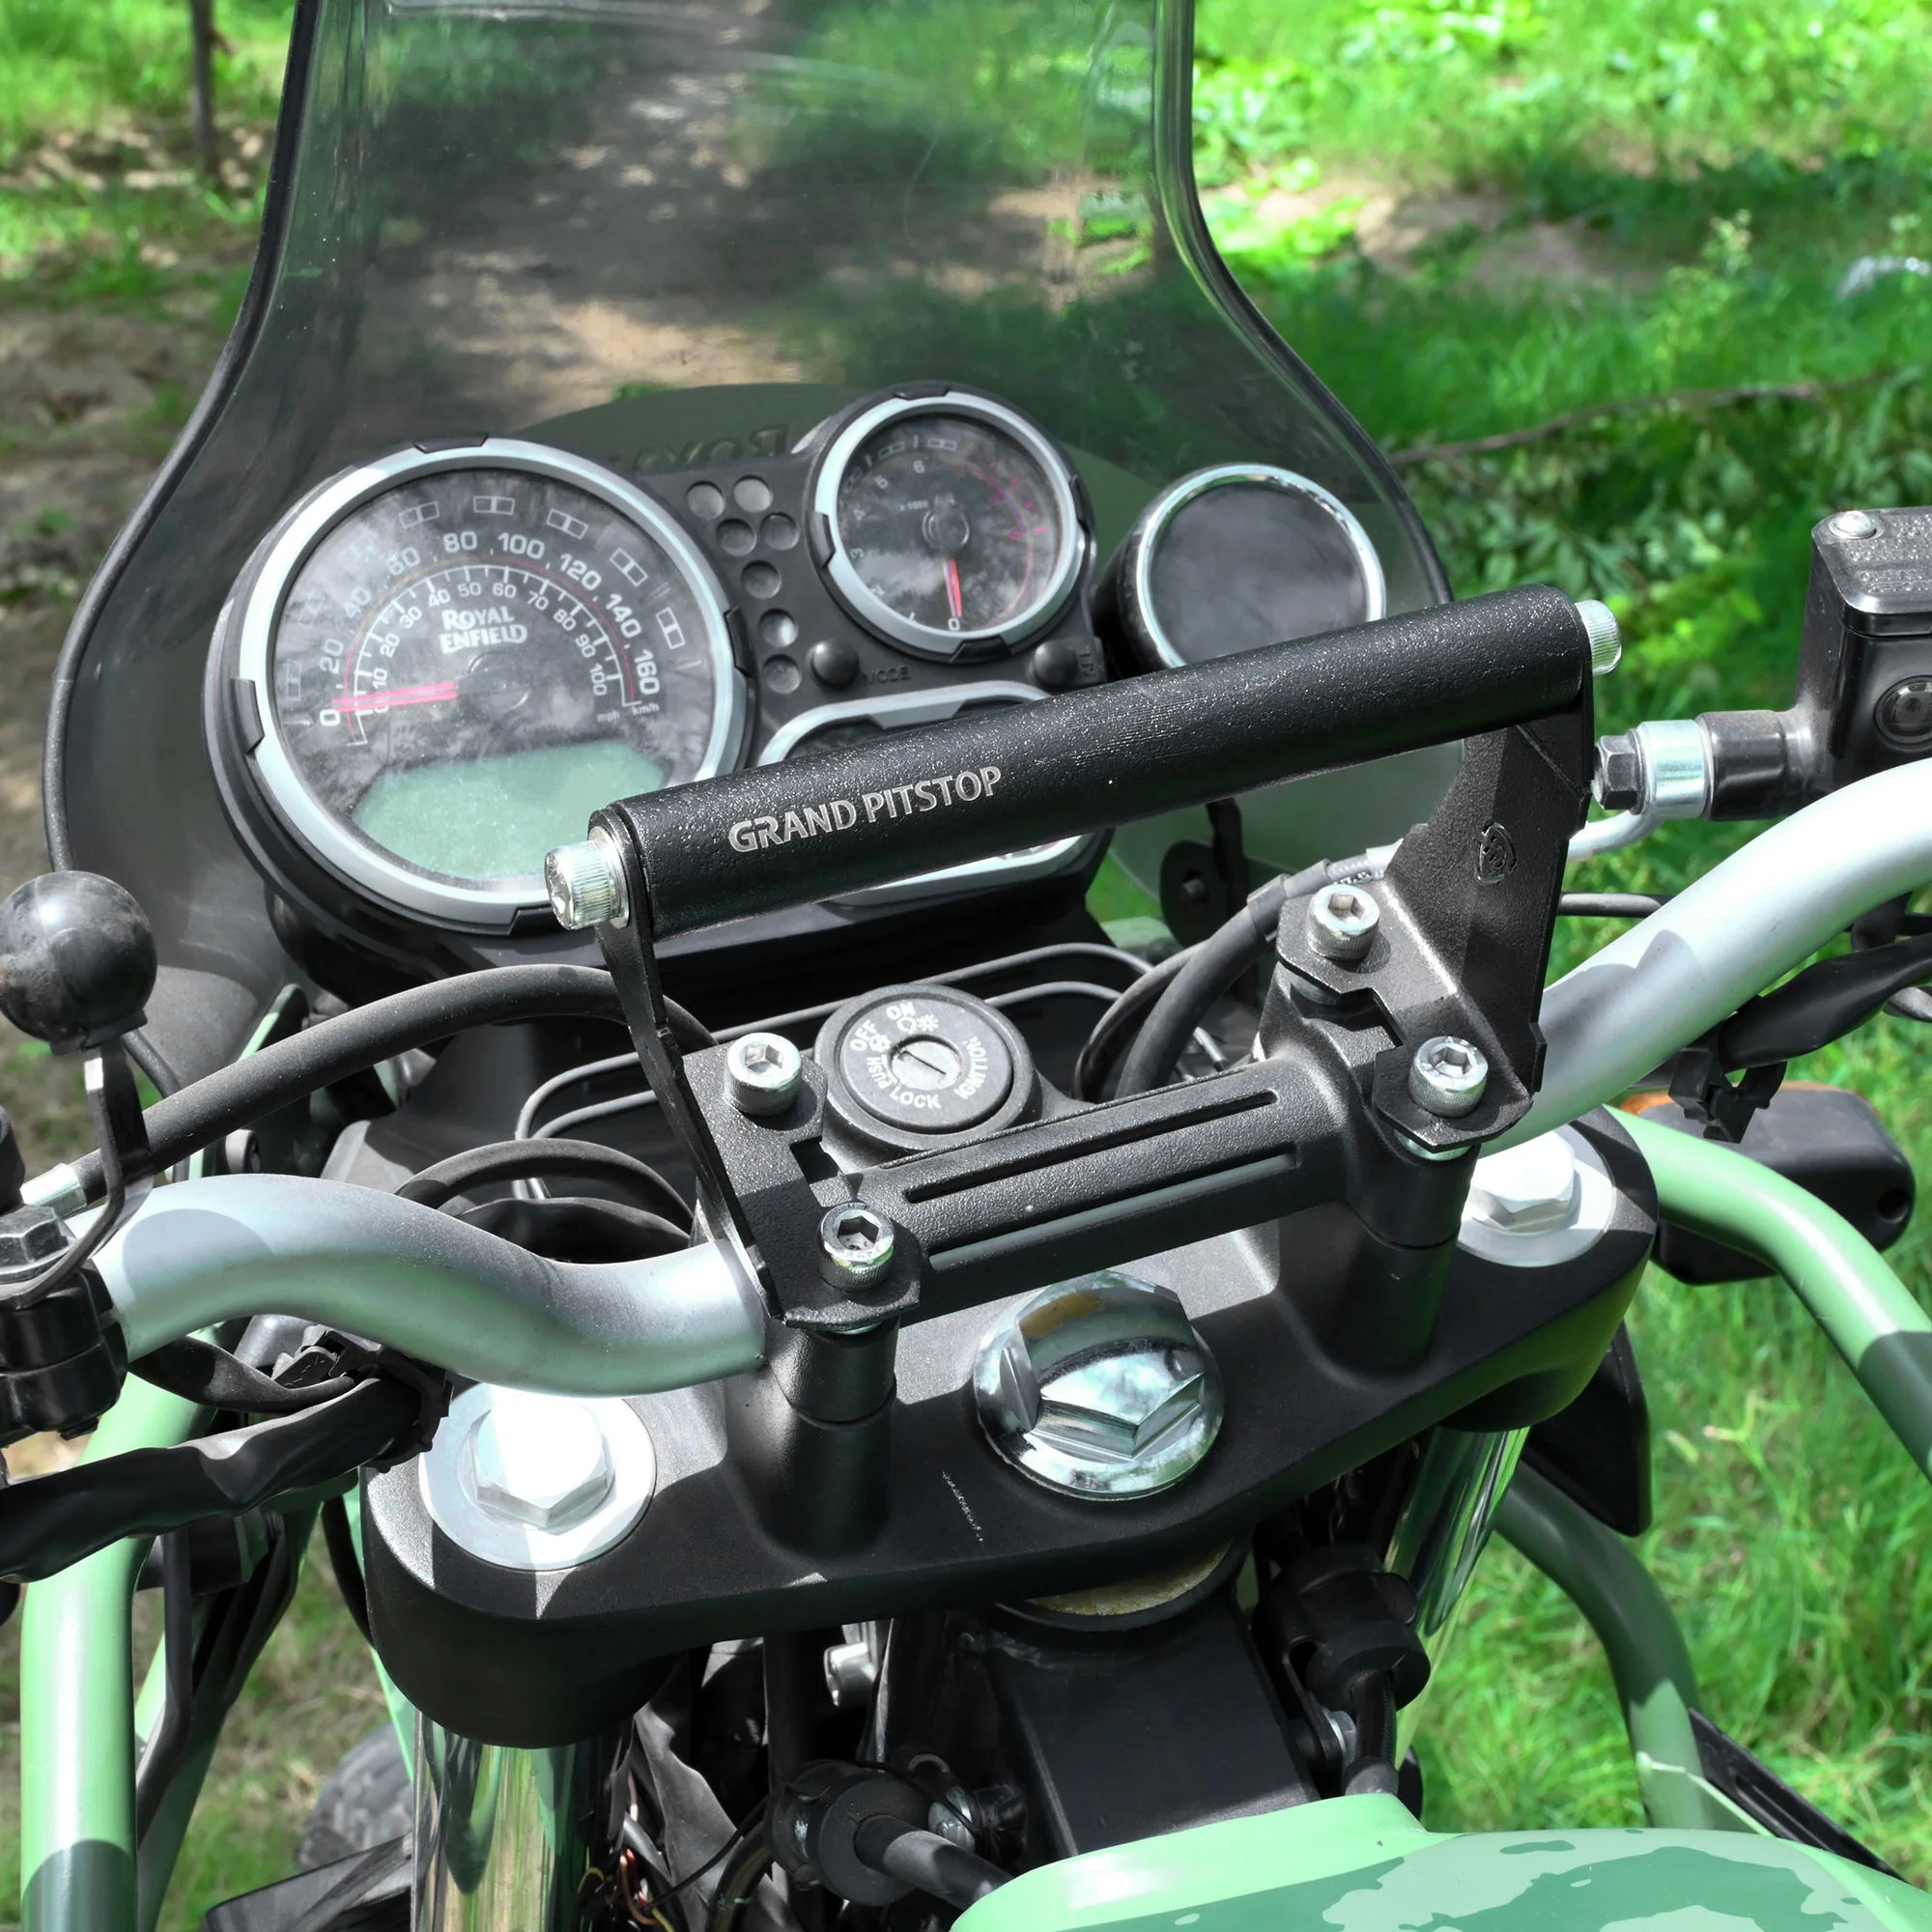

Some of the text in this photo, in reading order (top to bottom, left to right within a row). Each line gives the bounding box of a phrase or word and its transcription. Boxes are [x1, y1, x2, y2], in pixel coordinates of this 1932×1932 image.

[913, 460, 924, 474] 6
[874, 475, 889, 489] 5
[853, 508, 867, 523] 4
[850, 548, 865, 559] 3
[320, 531, 660, 727] 0 20 40 60 80 100 120 140 160
[441, 606, 515, 631] ROYAL
[948, 617, 961, 632] 0
[372, 668, 388, 691] 10
[380, 633, 400, 659] 20
[399, 606, 423, 629] 30
[428, 588, 451, 608] 40
[458, 582, 481, 597] 50
[493, 583, 517, 599] 60
[527, 591, 550, 611] 70
[554, 609, 577, 631] 80
[575, 634, 596, 659] 90
[588, 663, 608, 696] 100
[439, 623, 528, 654] ENFIELD
[596, 708, 621, 723] mph
[631, 701, 660, 716] km/h
[728, 766, 1002, 853] GRAND PITSTOP
[886, 1002, 917, 1020] ON
[850, 1019, 877, 1052] OFF
[867, 1056, 893, 1090] PUSH
[953, 1036, 988, 1099] IGNITION
[889, 1086, 943, 1109] LOCK
